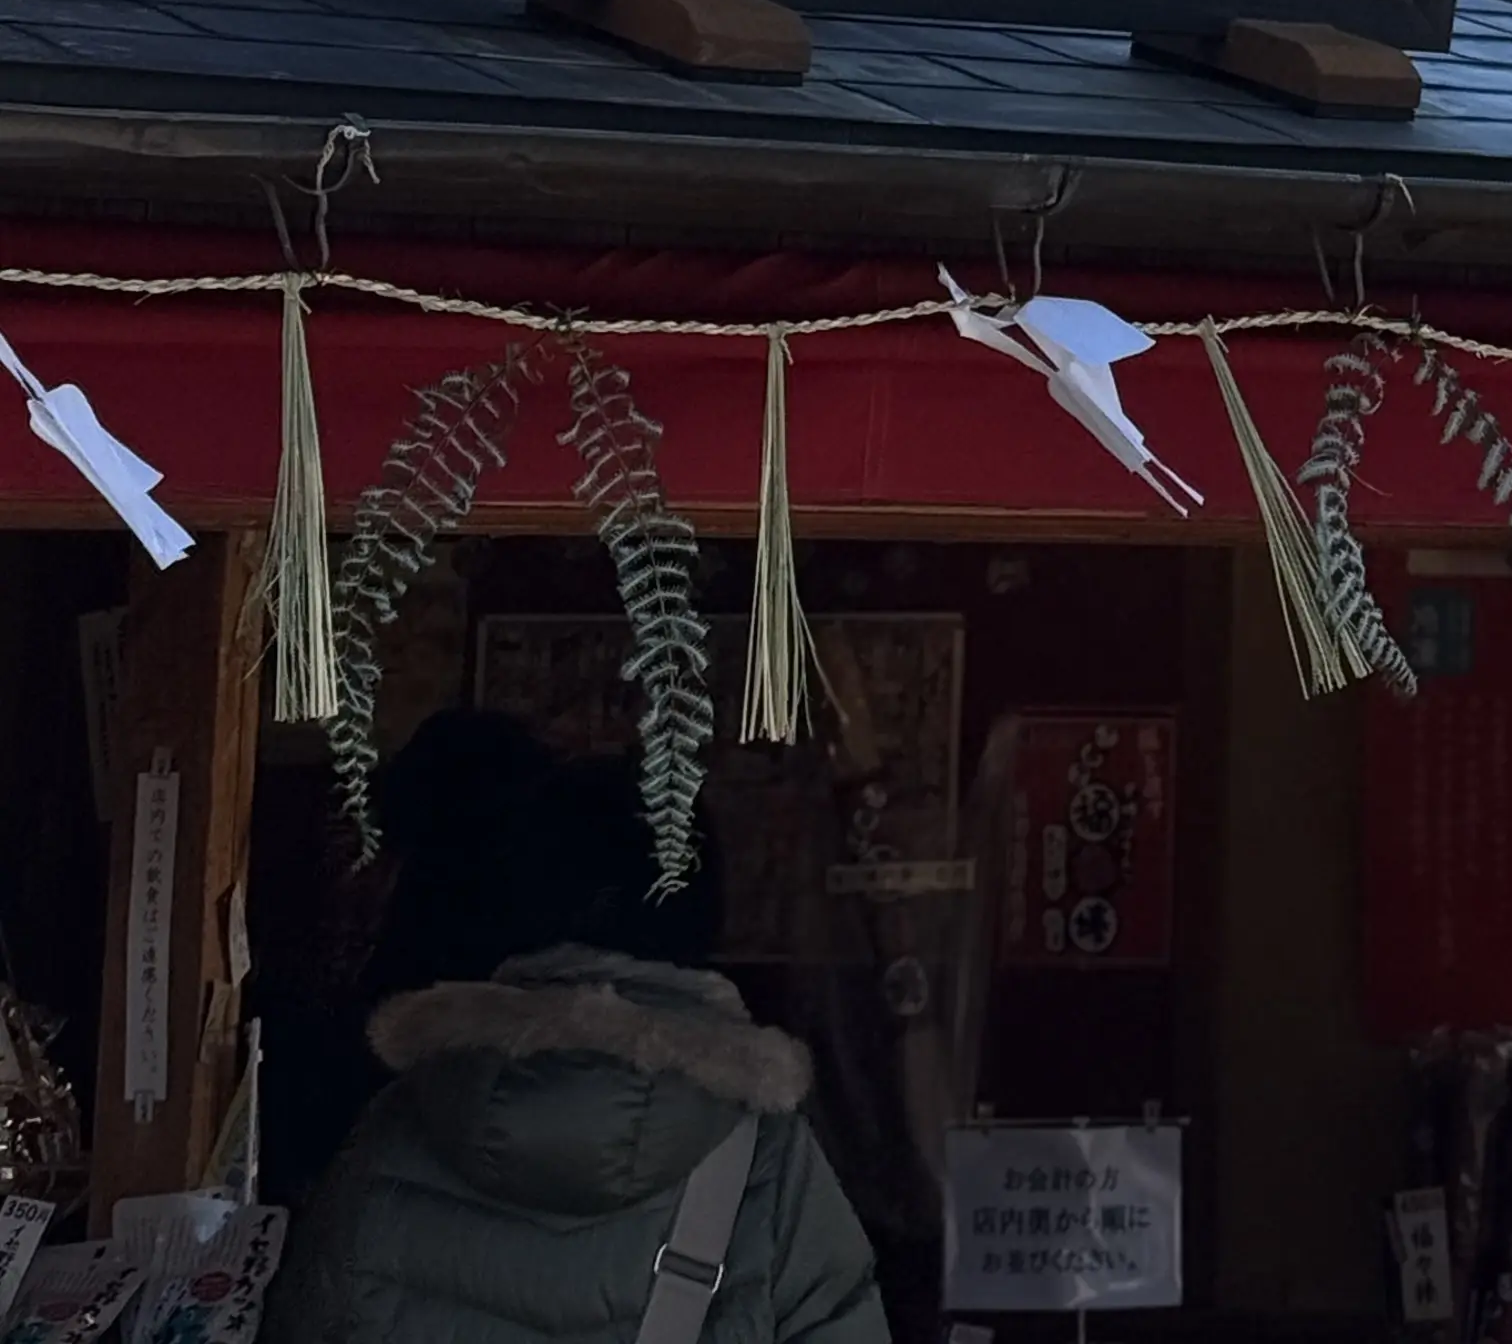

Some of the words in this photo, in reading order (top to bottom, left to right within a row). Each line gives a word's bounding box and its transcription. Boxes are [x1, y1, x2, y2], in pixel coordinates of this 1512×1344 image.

[1002, 1163, 1121, 1192] お会計の方
